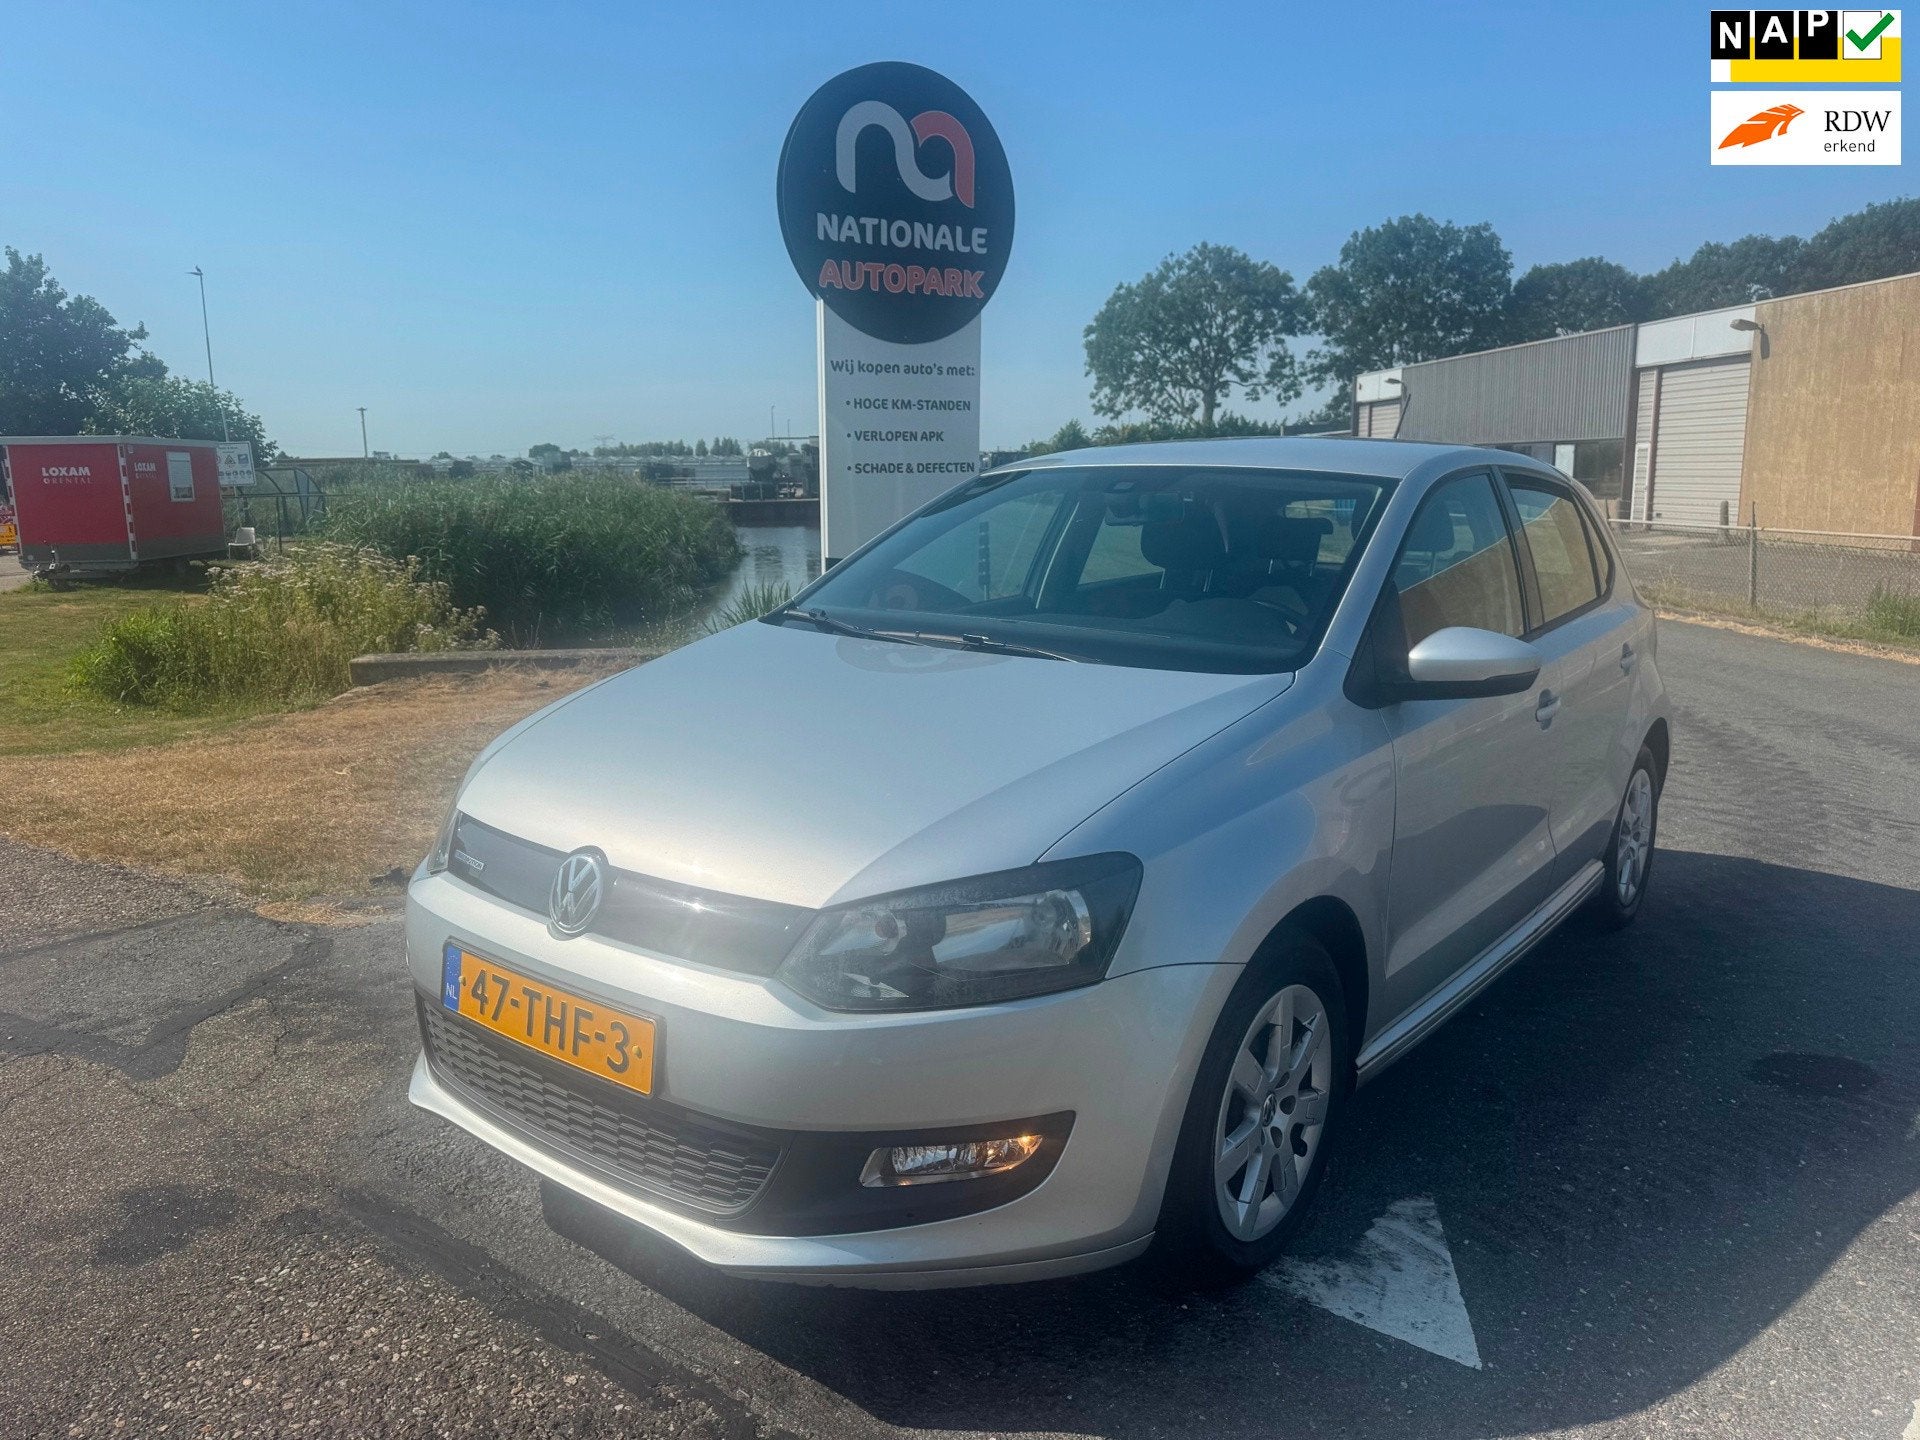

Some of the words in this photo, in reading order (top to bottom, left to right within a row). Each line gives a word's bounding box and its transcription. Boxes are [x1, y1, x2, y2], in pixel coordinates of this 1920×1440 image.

[816, 212, 988, 254] NATIONALE
[818, 258, 985, 299] AUTOPARK
[830, 359, 854, 375] Wij
[857, 360, 900, 376] kopen
[903, 362, 944, 376] auto's
[946, 364, 976, 377] met:
[853, 398, 889, 410] HOGE
[891, 399, 971, 411] KM-STANDEN
[854, 430, 918, 442] VERLOPEN
[920, 430, 945, 442] APK
[41, 466, 91, 477] LOXAM
[854, 462, 904, 474] SCHADE
[905, 462, 914, 474] &
[916, 462, 975, 474] DEFECTEN
[445, 982, 458, 1000] NL
[470, 968, 630, 1074] 47-THF-3
